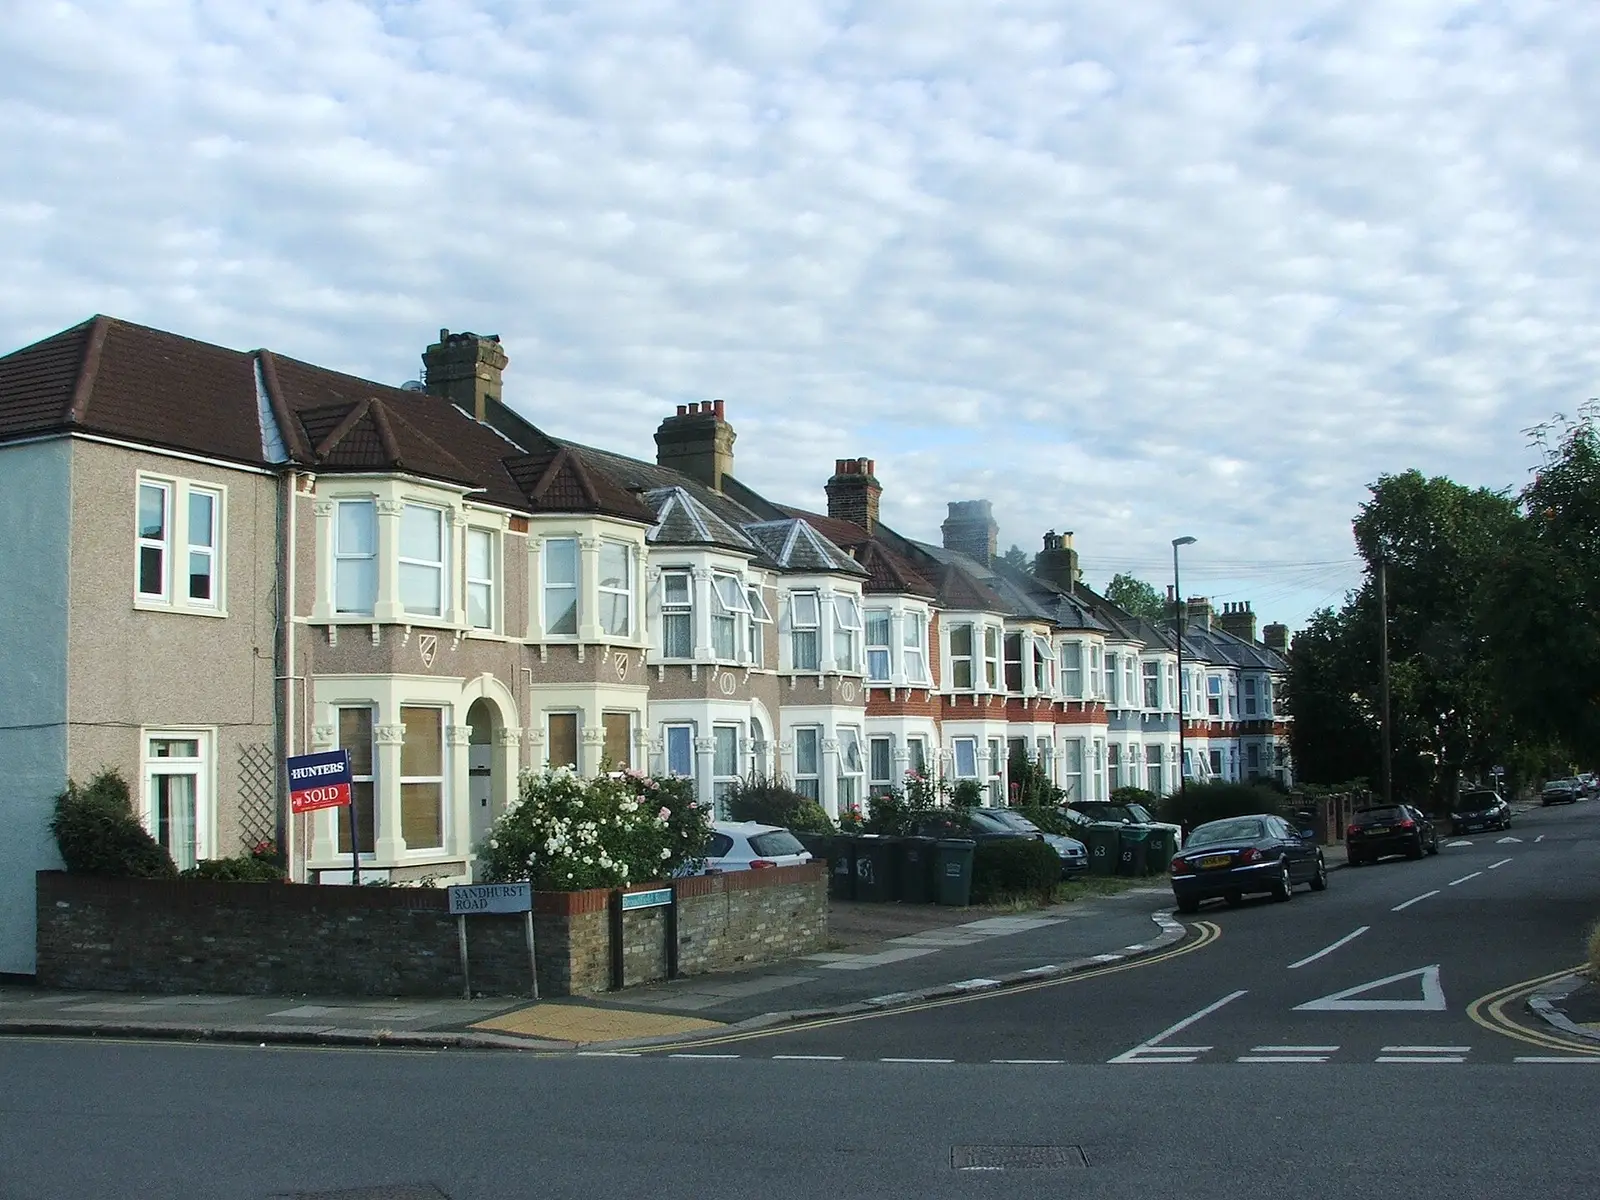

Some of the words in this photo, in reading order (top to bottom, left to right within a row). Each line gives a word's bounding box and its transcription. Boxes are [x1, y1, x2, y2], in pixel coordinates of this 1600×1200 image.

[291, 762, 344, 779] HUNTERS
[304, 787, 338, 804] SOLD
[1094, 845, 1106, 857] 63
[1122, 851, 1132, 861] 63
[455, 886, 525, 899] SANDHURST
[456, 899, 488, 910] ROAD
